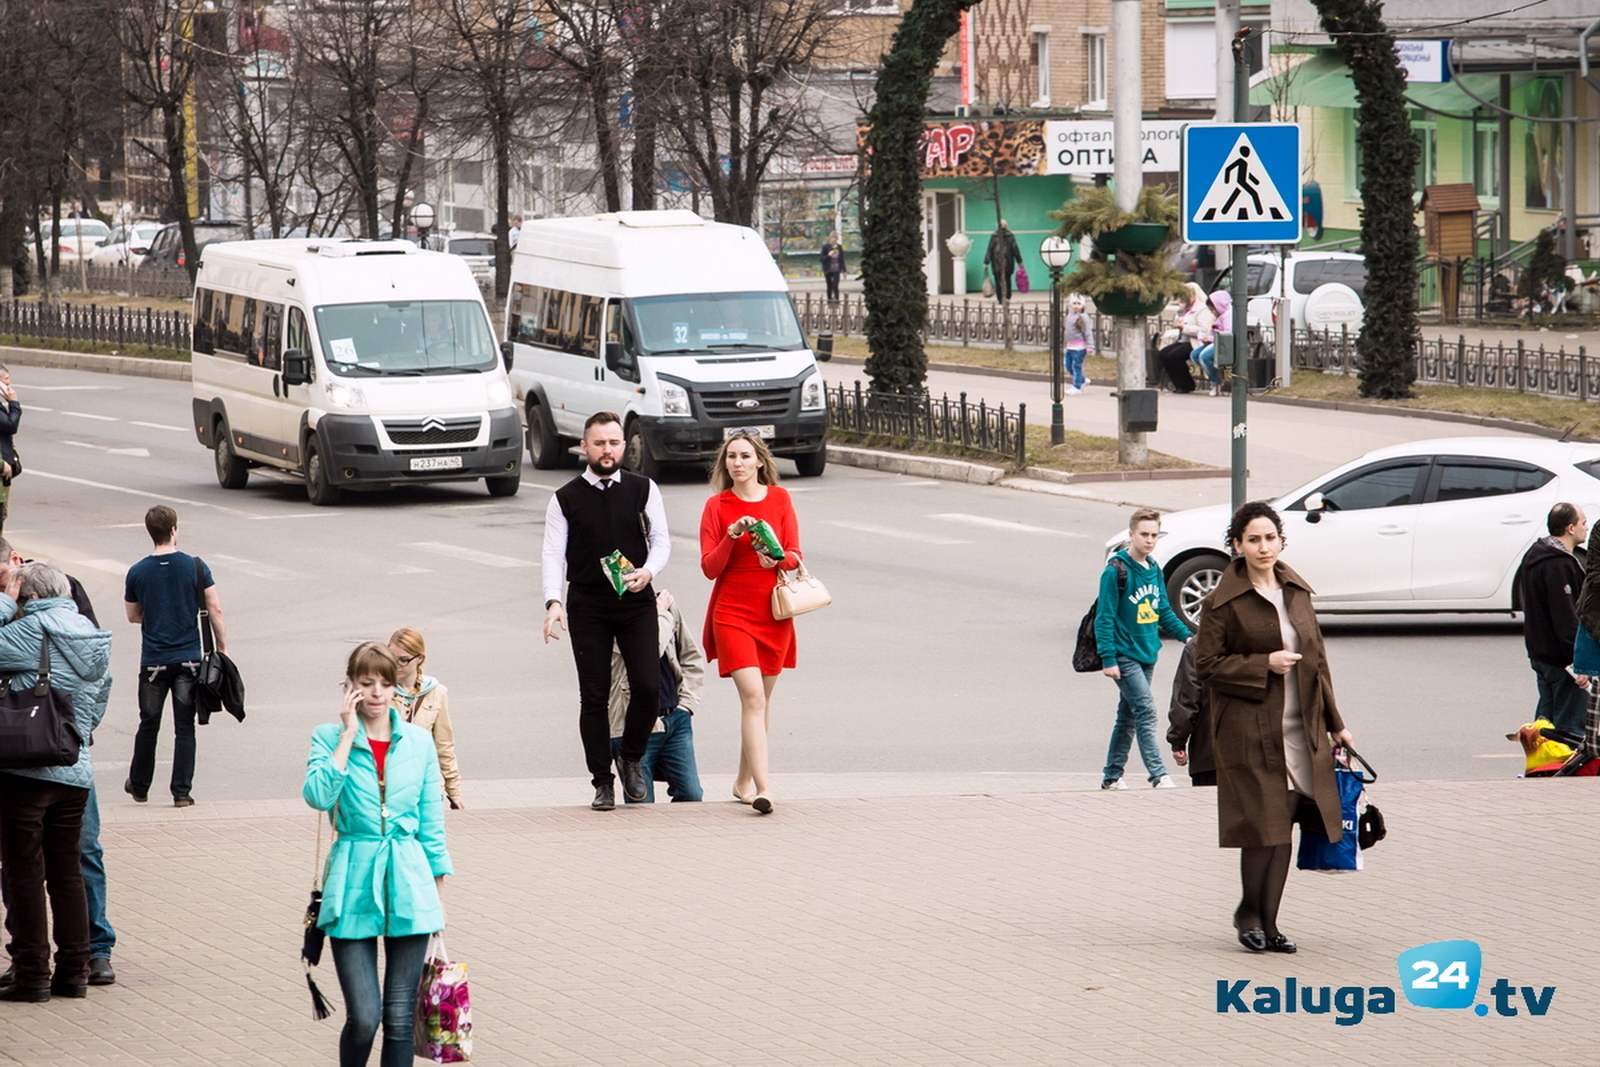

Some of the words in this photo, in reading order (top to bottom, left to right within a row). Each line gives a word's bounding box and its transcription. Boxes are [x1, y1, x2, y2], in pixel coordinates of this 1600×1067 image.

[675, 326, 688, 343] 32
[334, 345, 354, 357] 26
[1342, 820, 1353, 830] KI
